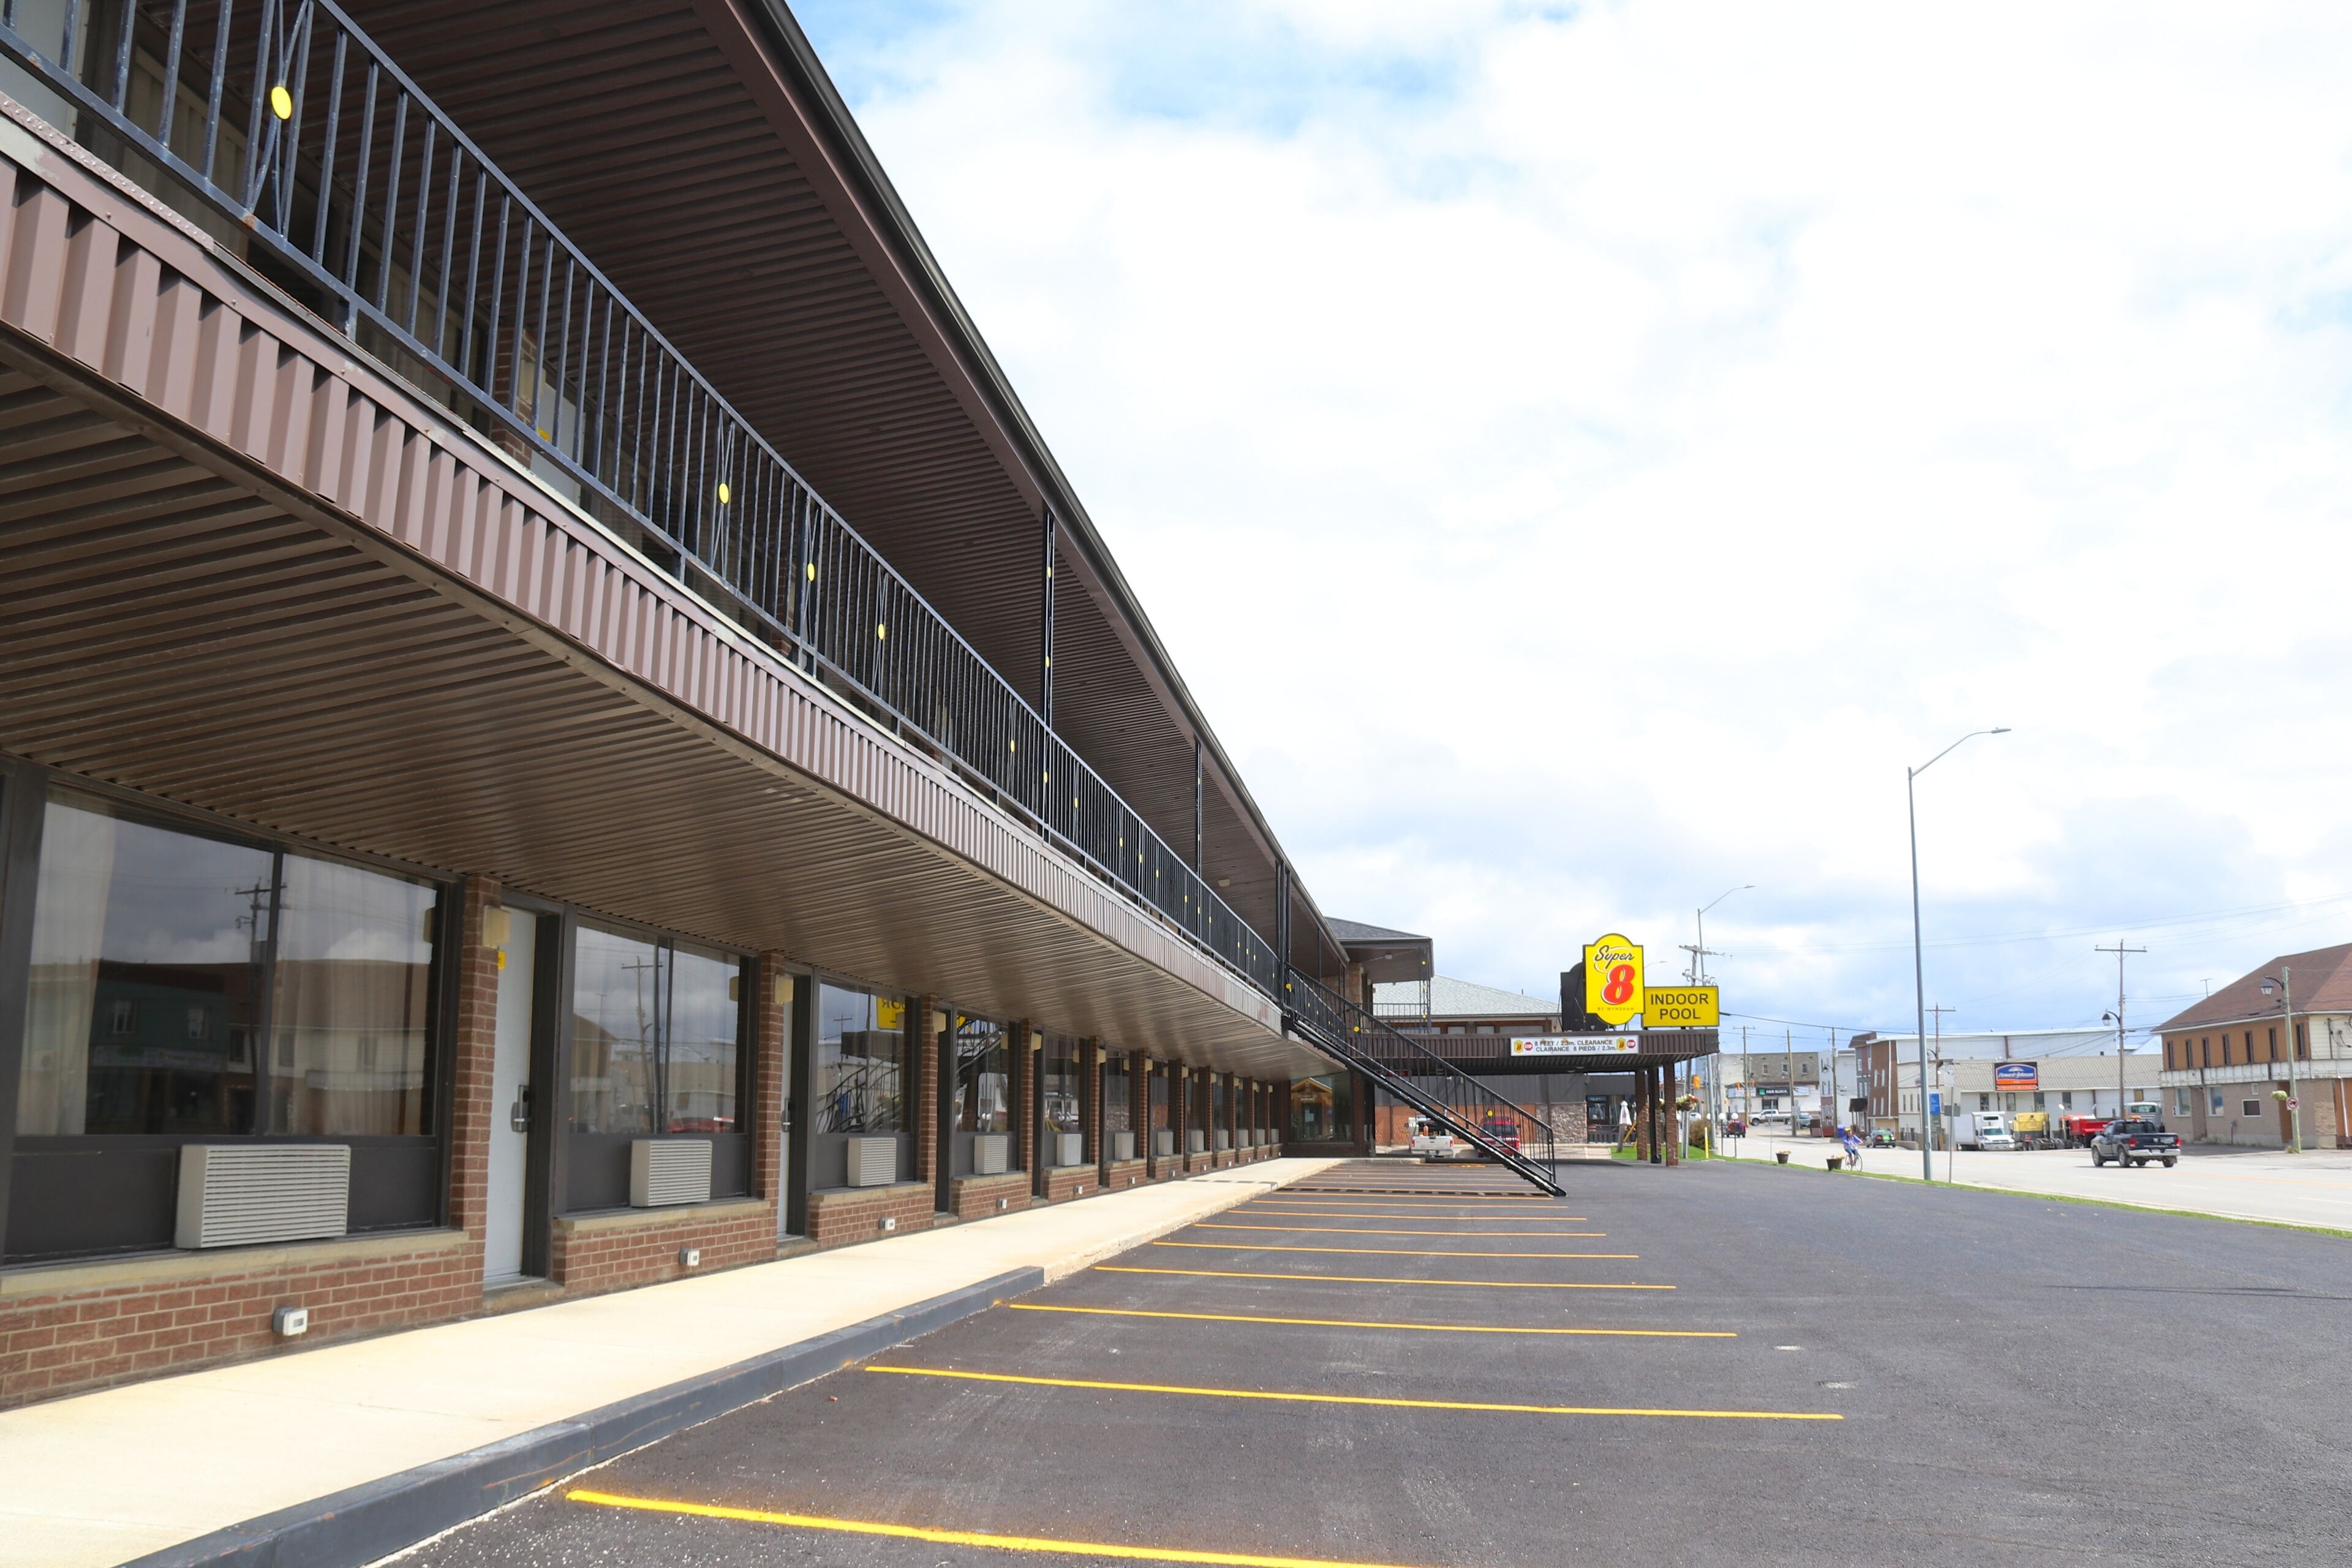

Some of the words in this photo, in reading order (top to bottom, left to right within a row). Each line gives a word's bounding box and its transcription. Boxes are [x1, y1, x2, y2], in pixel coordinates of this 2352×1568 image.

[1594, 944, 1635, 969] Super
[1601, 964, 1635, 1005] 8
[1650, 993, 1709, 1005] INDOOR
[1659, 1008, 1701, 1020] POOL
